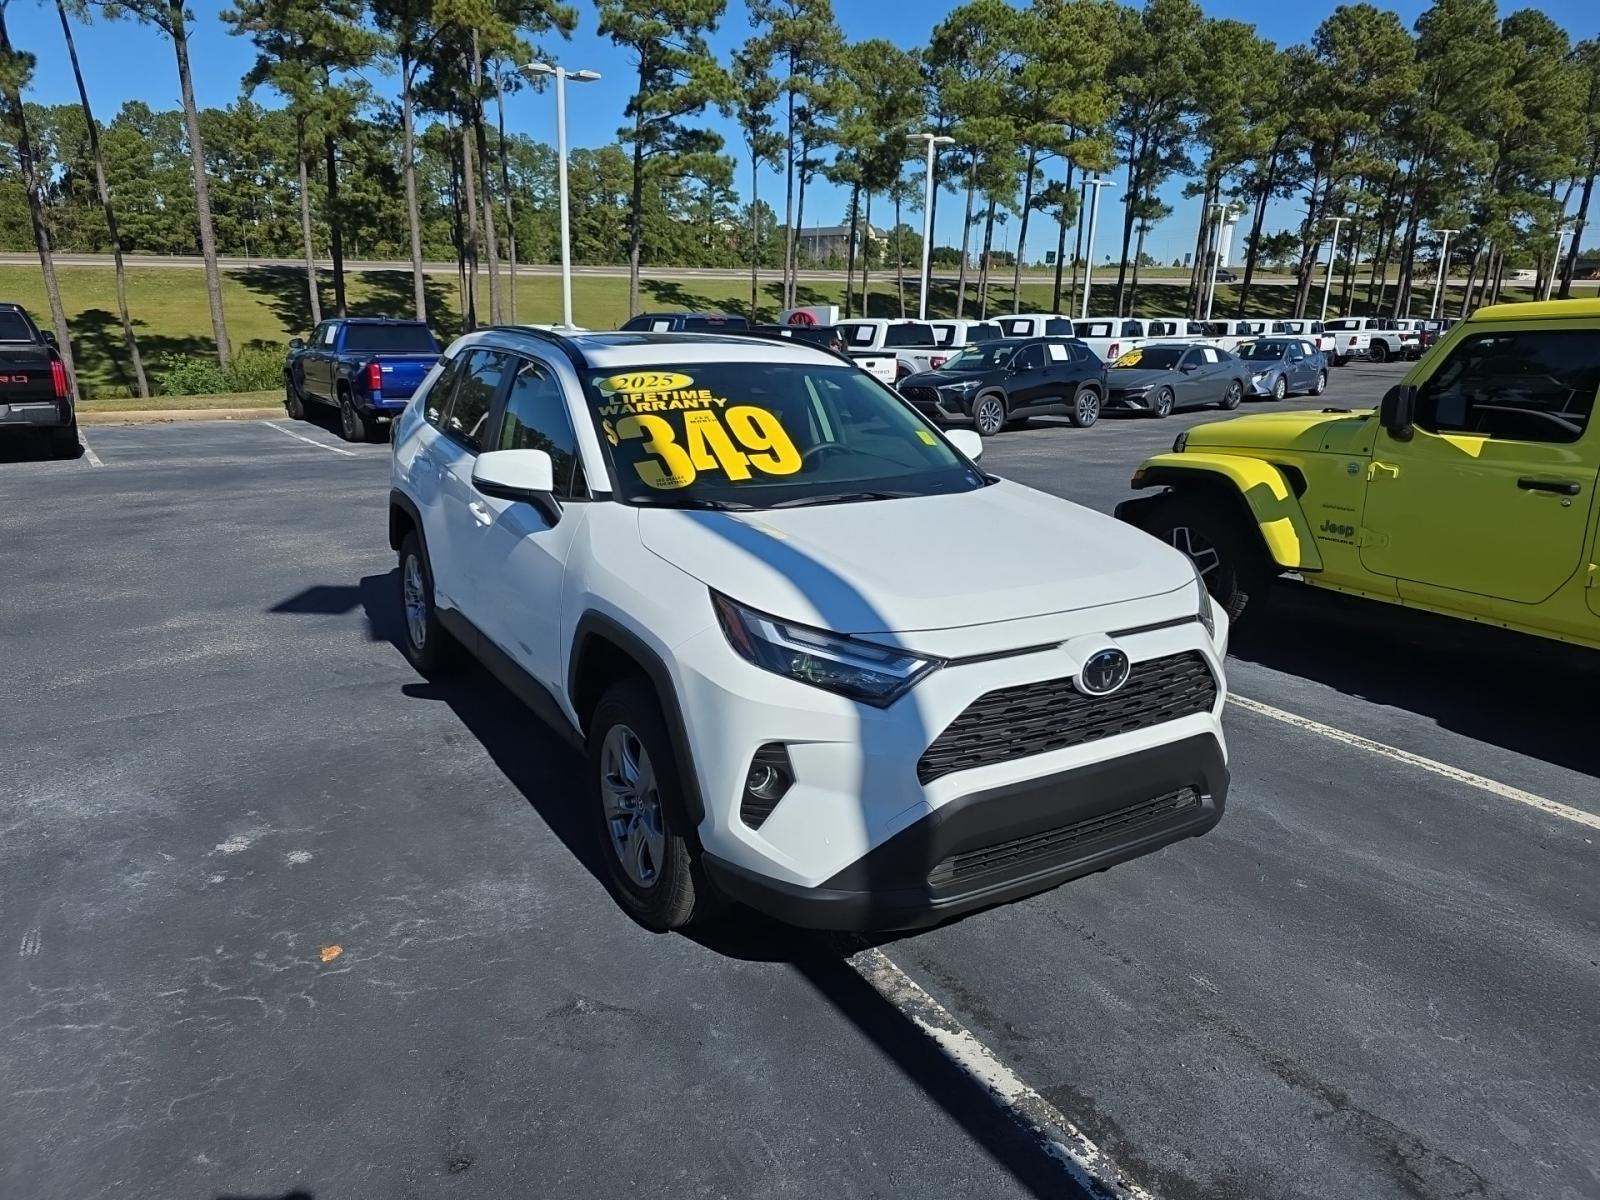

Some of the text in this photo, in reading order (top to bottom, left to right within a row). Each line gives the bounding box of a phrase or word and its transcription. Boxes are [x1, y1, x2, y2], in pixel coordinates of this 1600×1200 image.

[615, 375, 674, 390] 2025
[609, 390, 713, 406] LIFETIME
[599, 398, 728, 416] WARRANTY
[602, 405, 803, 490] $349
[1320, 520, 1354, 537] Jeep
